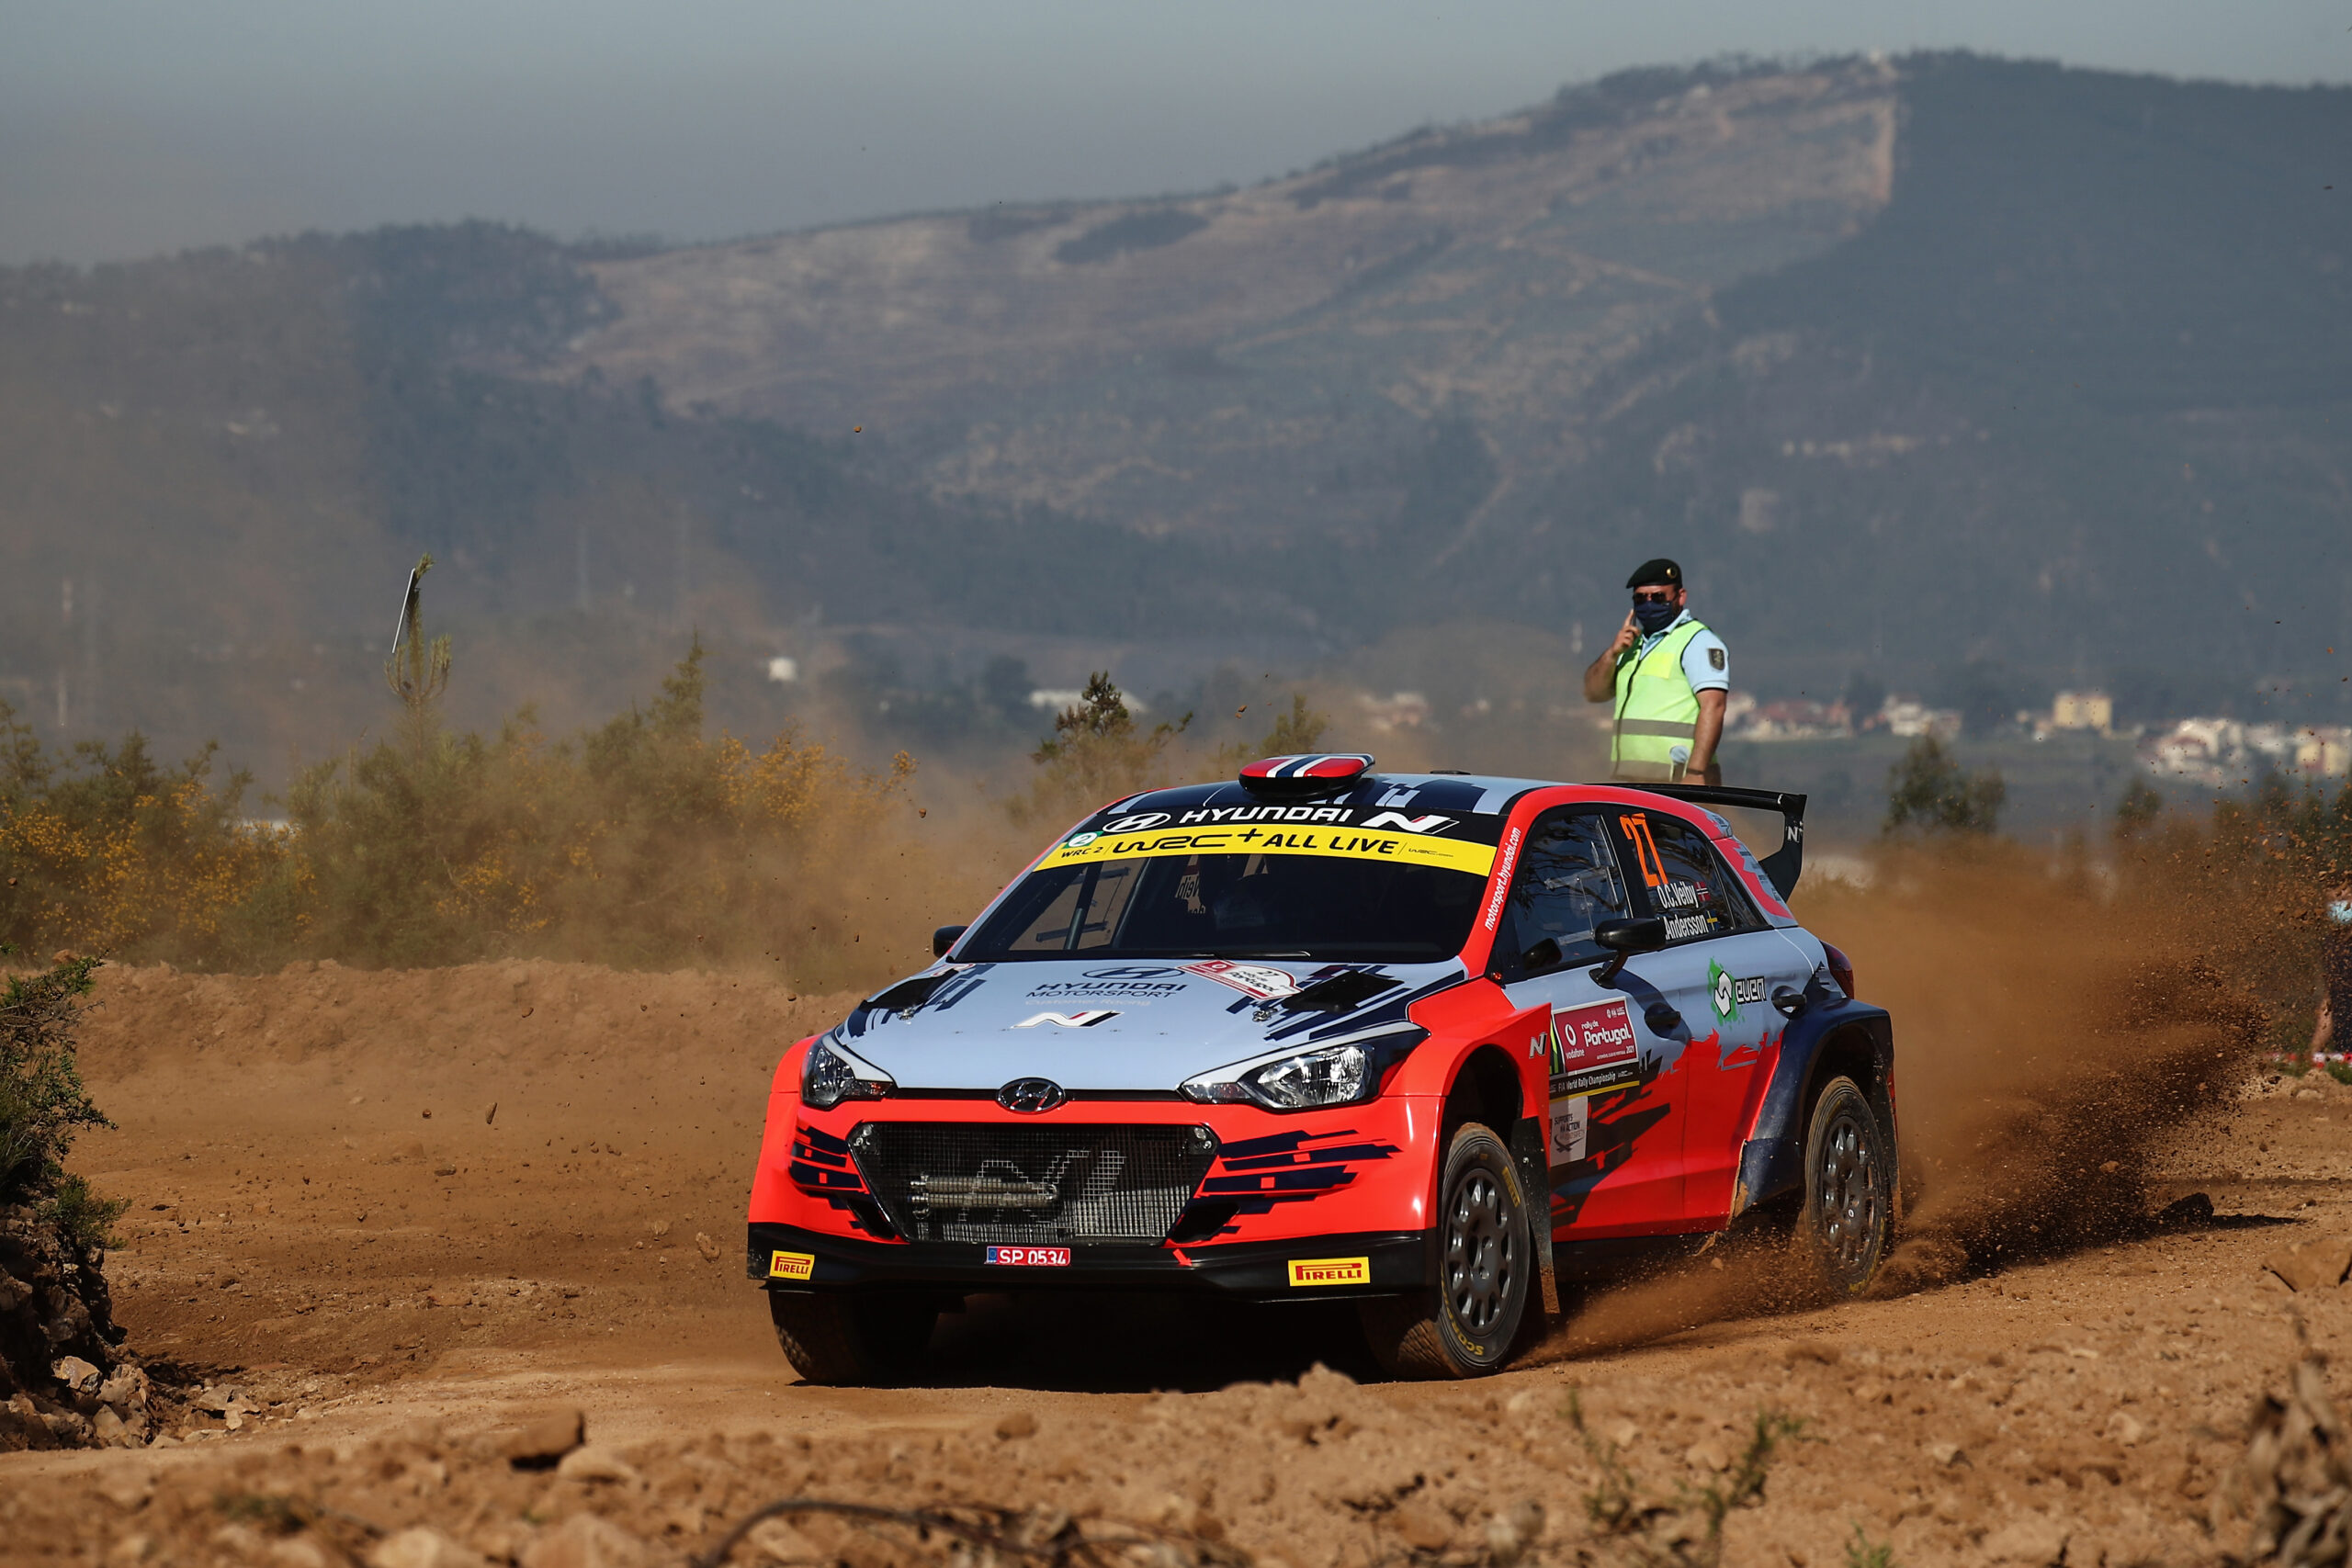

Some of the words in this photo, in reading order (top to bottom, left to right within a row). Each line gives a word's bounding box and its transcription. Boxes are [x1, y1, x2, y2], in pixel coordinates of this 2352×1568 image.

[1179, 807, 1353, 823] HYUNDAI
[1061, 848, 1091, 858] WRC
[1093, 846, 1103, 854] 2
[1261, 833, 1317, 848] ALL
[1329, 836, 1399, 854] LIVE
[1619, 813, 1668, 887] 27
[1485, 827, 1521, 931] motorsport.hyundai.com
[1657, 881, 1699, 908] O.C.Veiby
[1025, 990, 1177, 998] MOTORSPORT
[1035, 982, 1188, 991] HYUNDAI
[1583, 1023, 1632, 1047] Portugal
[1565, 1048, 1585, 1059] vodafone
[1566, 1078, 1577, 1089] World
[1577, 1077, 1589, 1089] Rally
[1589, 1070, 1616, 1086] Championship
[775, 1256, 810, 1274] PIRELLI
[1000, 1250, 1023, 1264] SP
[1028, 1251, 1066, 1265] 0534
[1295, 1263, 1362, 1280] PIRELLI
